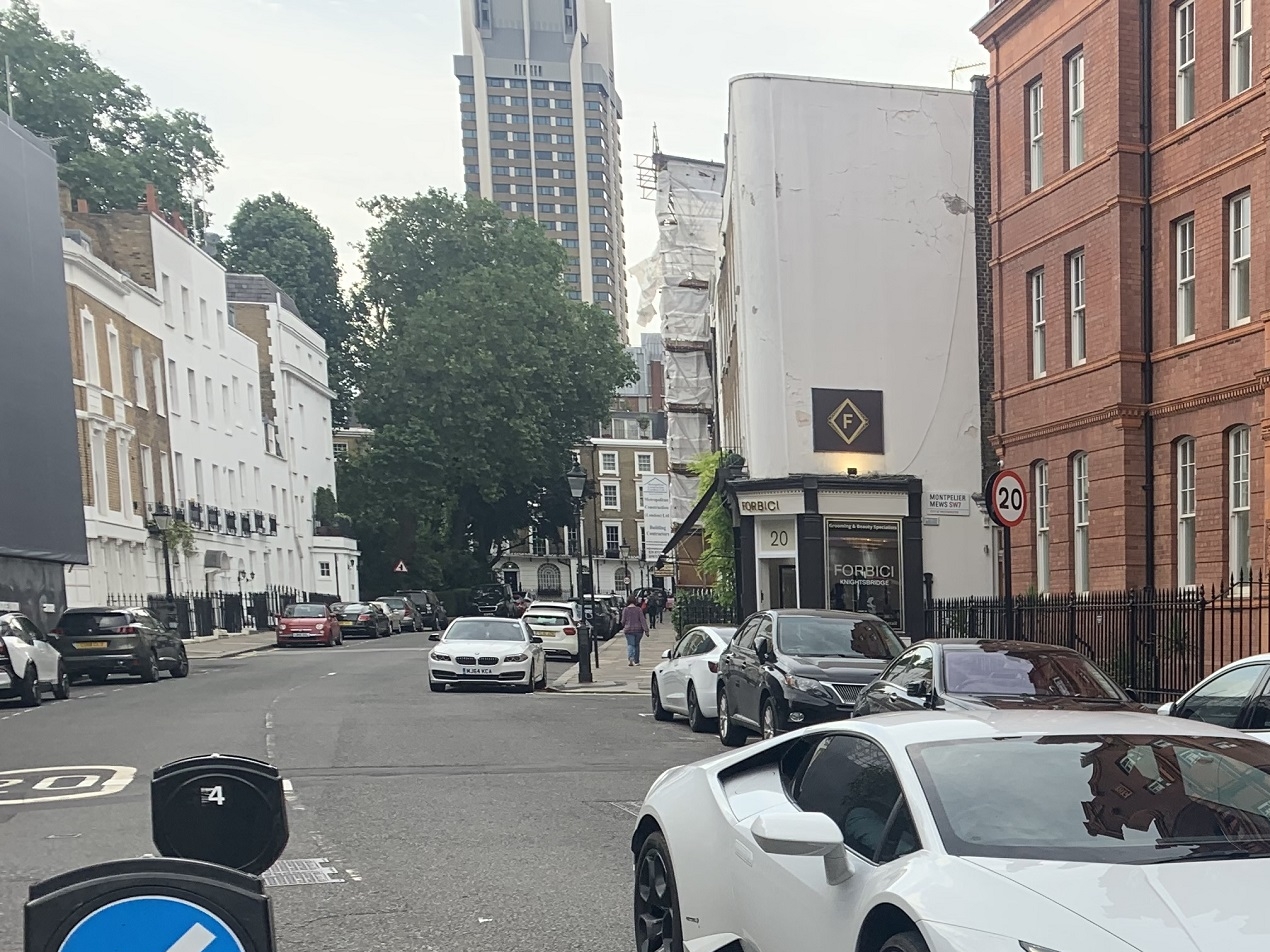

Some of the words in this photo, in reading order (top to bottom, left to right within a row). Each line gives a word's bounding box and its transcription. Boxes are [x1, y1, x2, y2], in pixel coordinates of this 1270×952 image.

[843, 413, 853, 429] F
[741, 501, 780, 512] FORBICI
[999, 486, 1023, 511] 20
[770, 530, 788, 547] 20
[834, 564, 894, 578] FORBICI
[207, 785, 226, 806] 4
